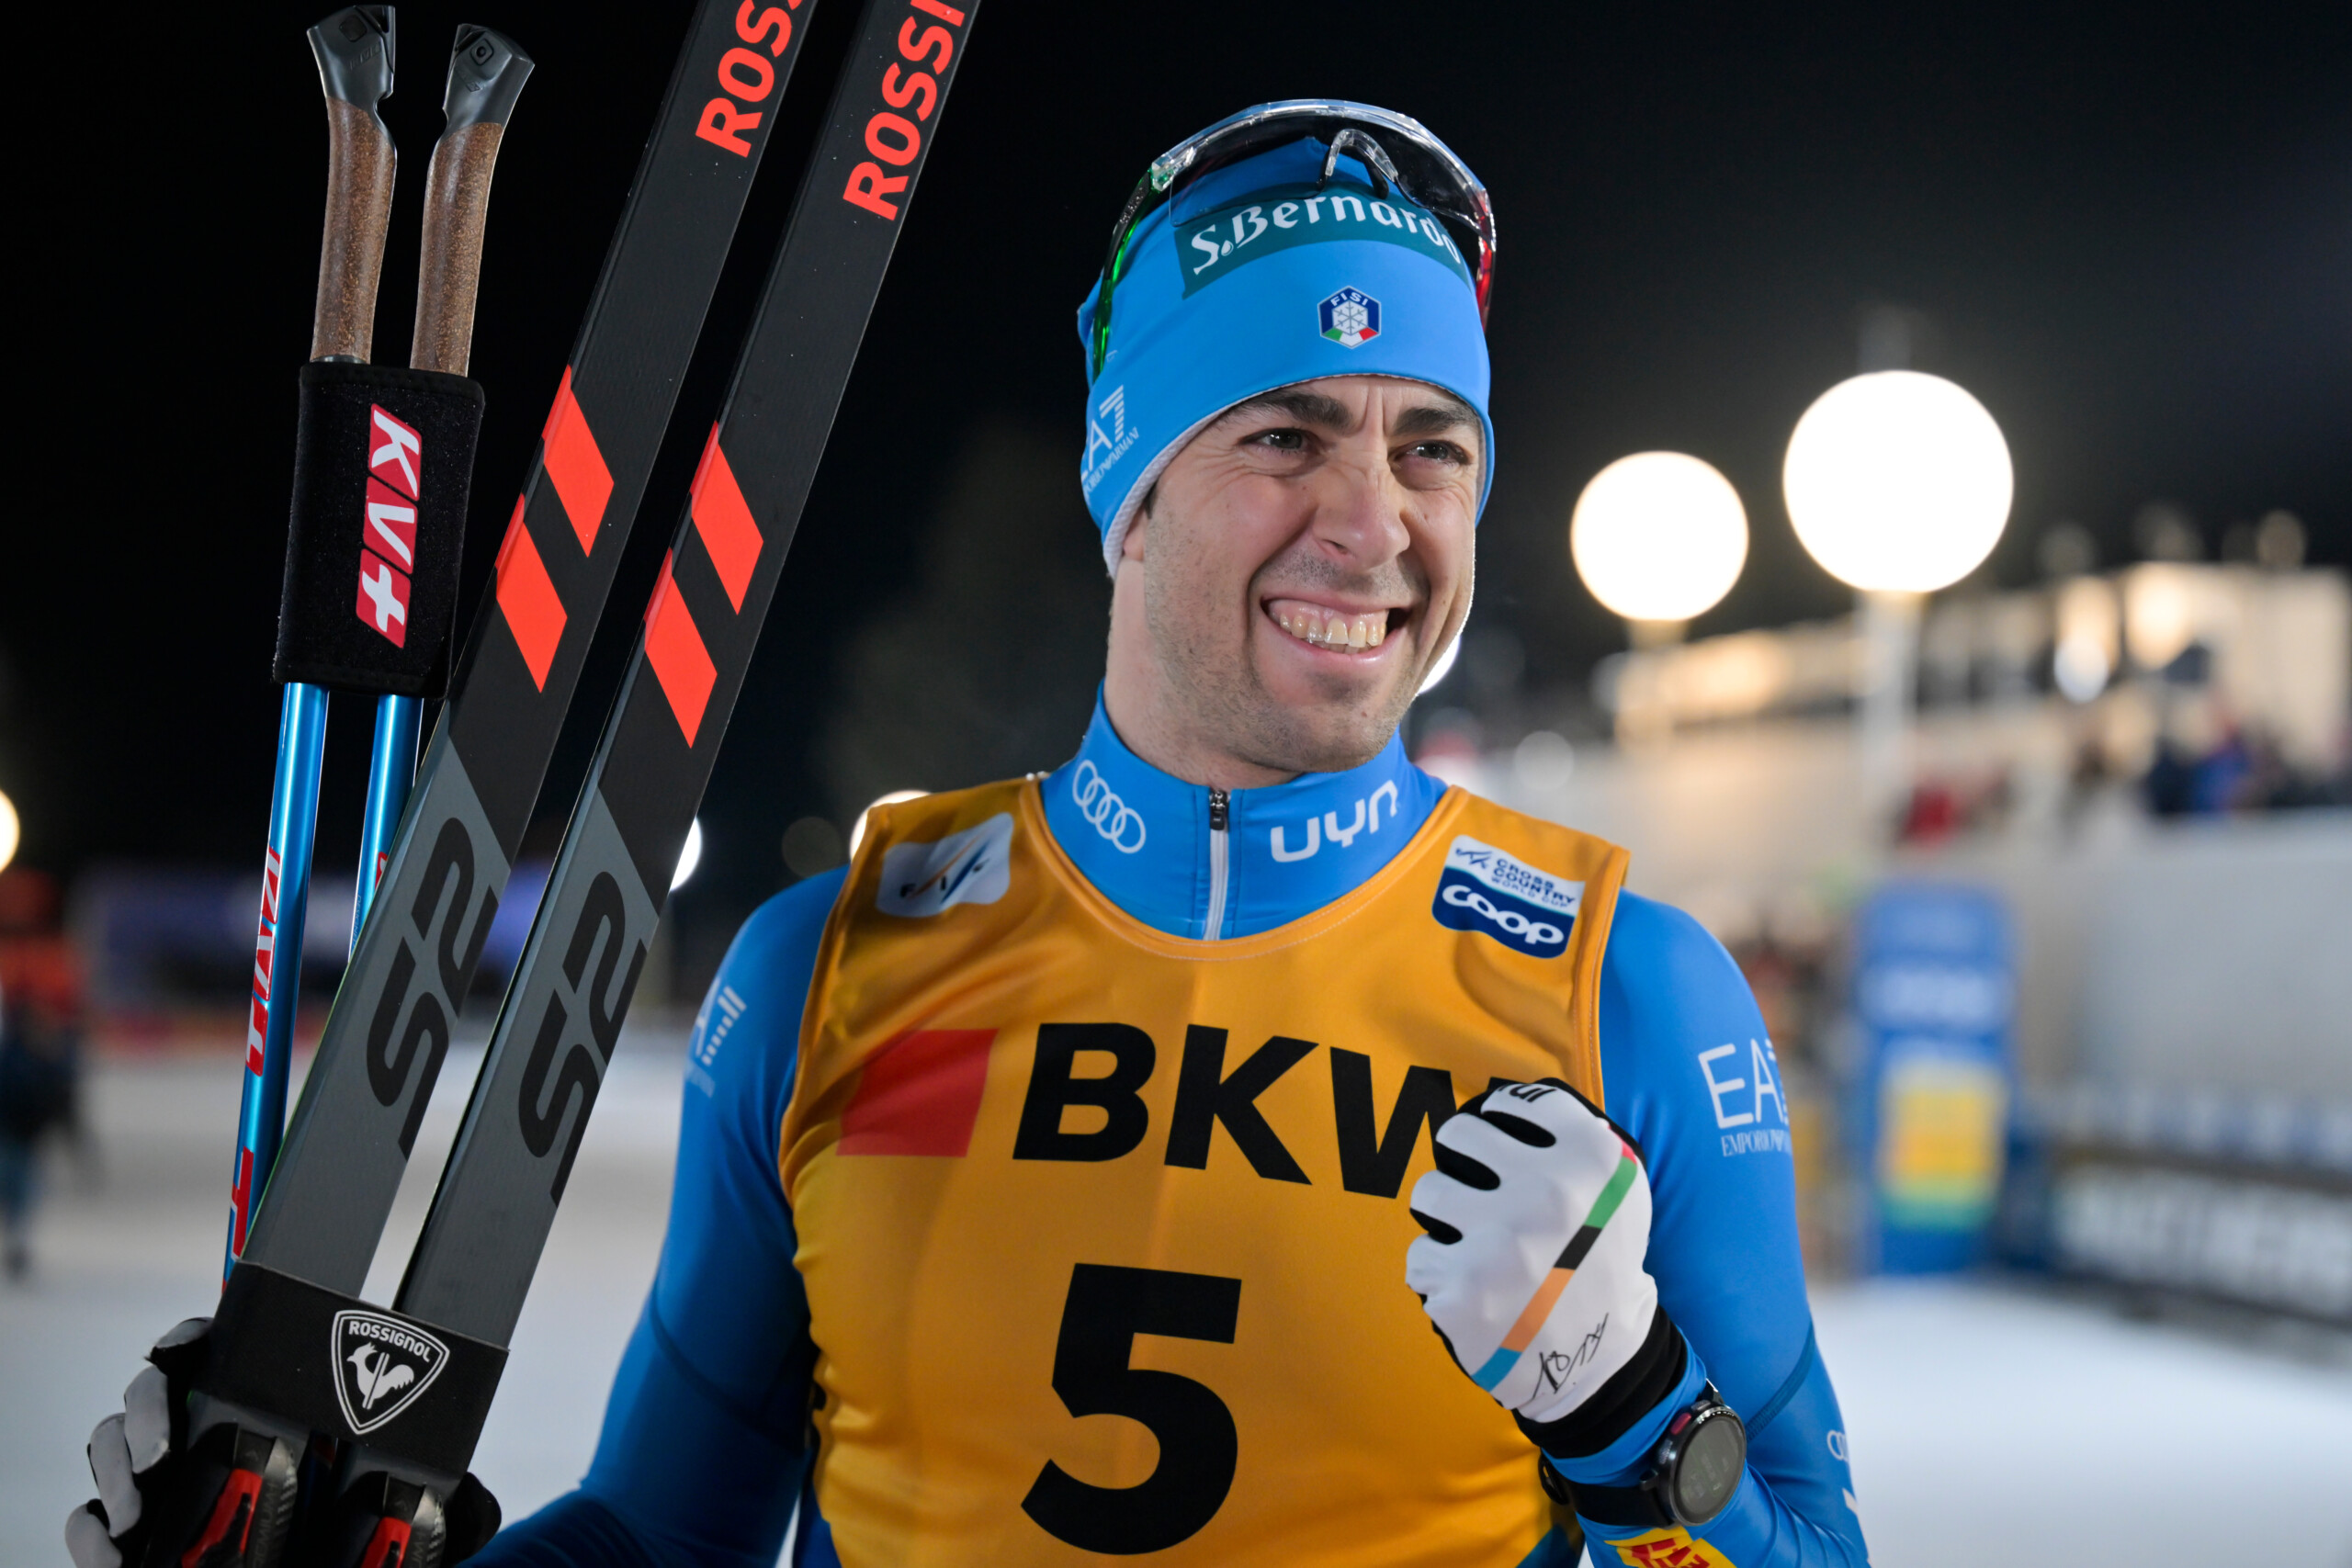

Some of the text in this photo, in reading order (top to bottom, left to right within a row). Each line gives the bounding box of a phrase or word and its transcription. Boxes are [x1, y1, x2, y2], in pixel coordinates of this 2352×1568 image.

[695, 0, 802, 158] ROS
[1330, 292, 1369, 307] FISI
[360, 408, 420, 634] KV+
[1491, 875, 1568, 908] WORLD CUP
[1493, 867, 1577, 905] COUNTRY
[1497, 858, 1555, 890] CROSS
[1012, 1021, 1521, 1200] BKW
[348, 1320, 431, 1363] ROSSIGNOL
[1021, 1263, 1242, 1555] 5
